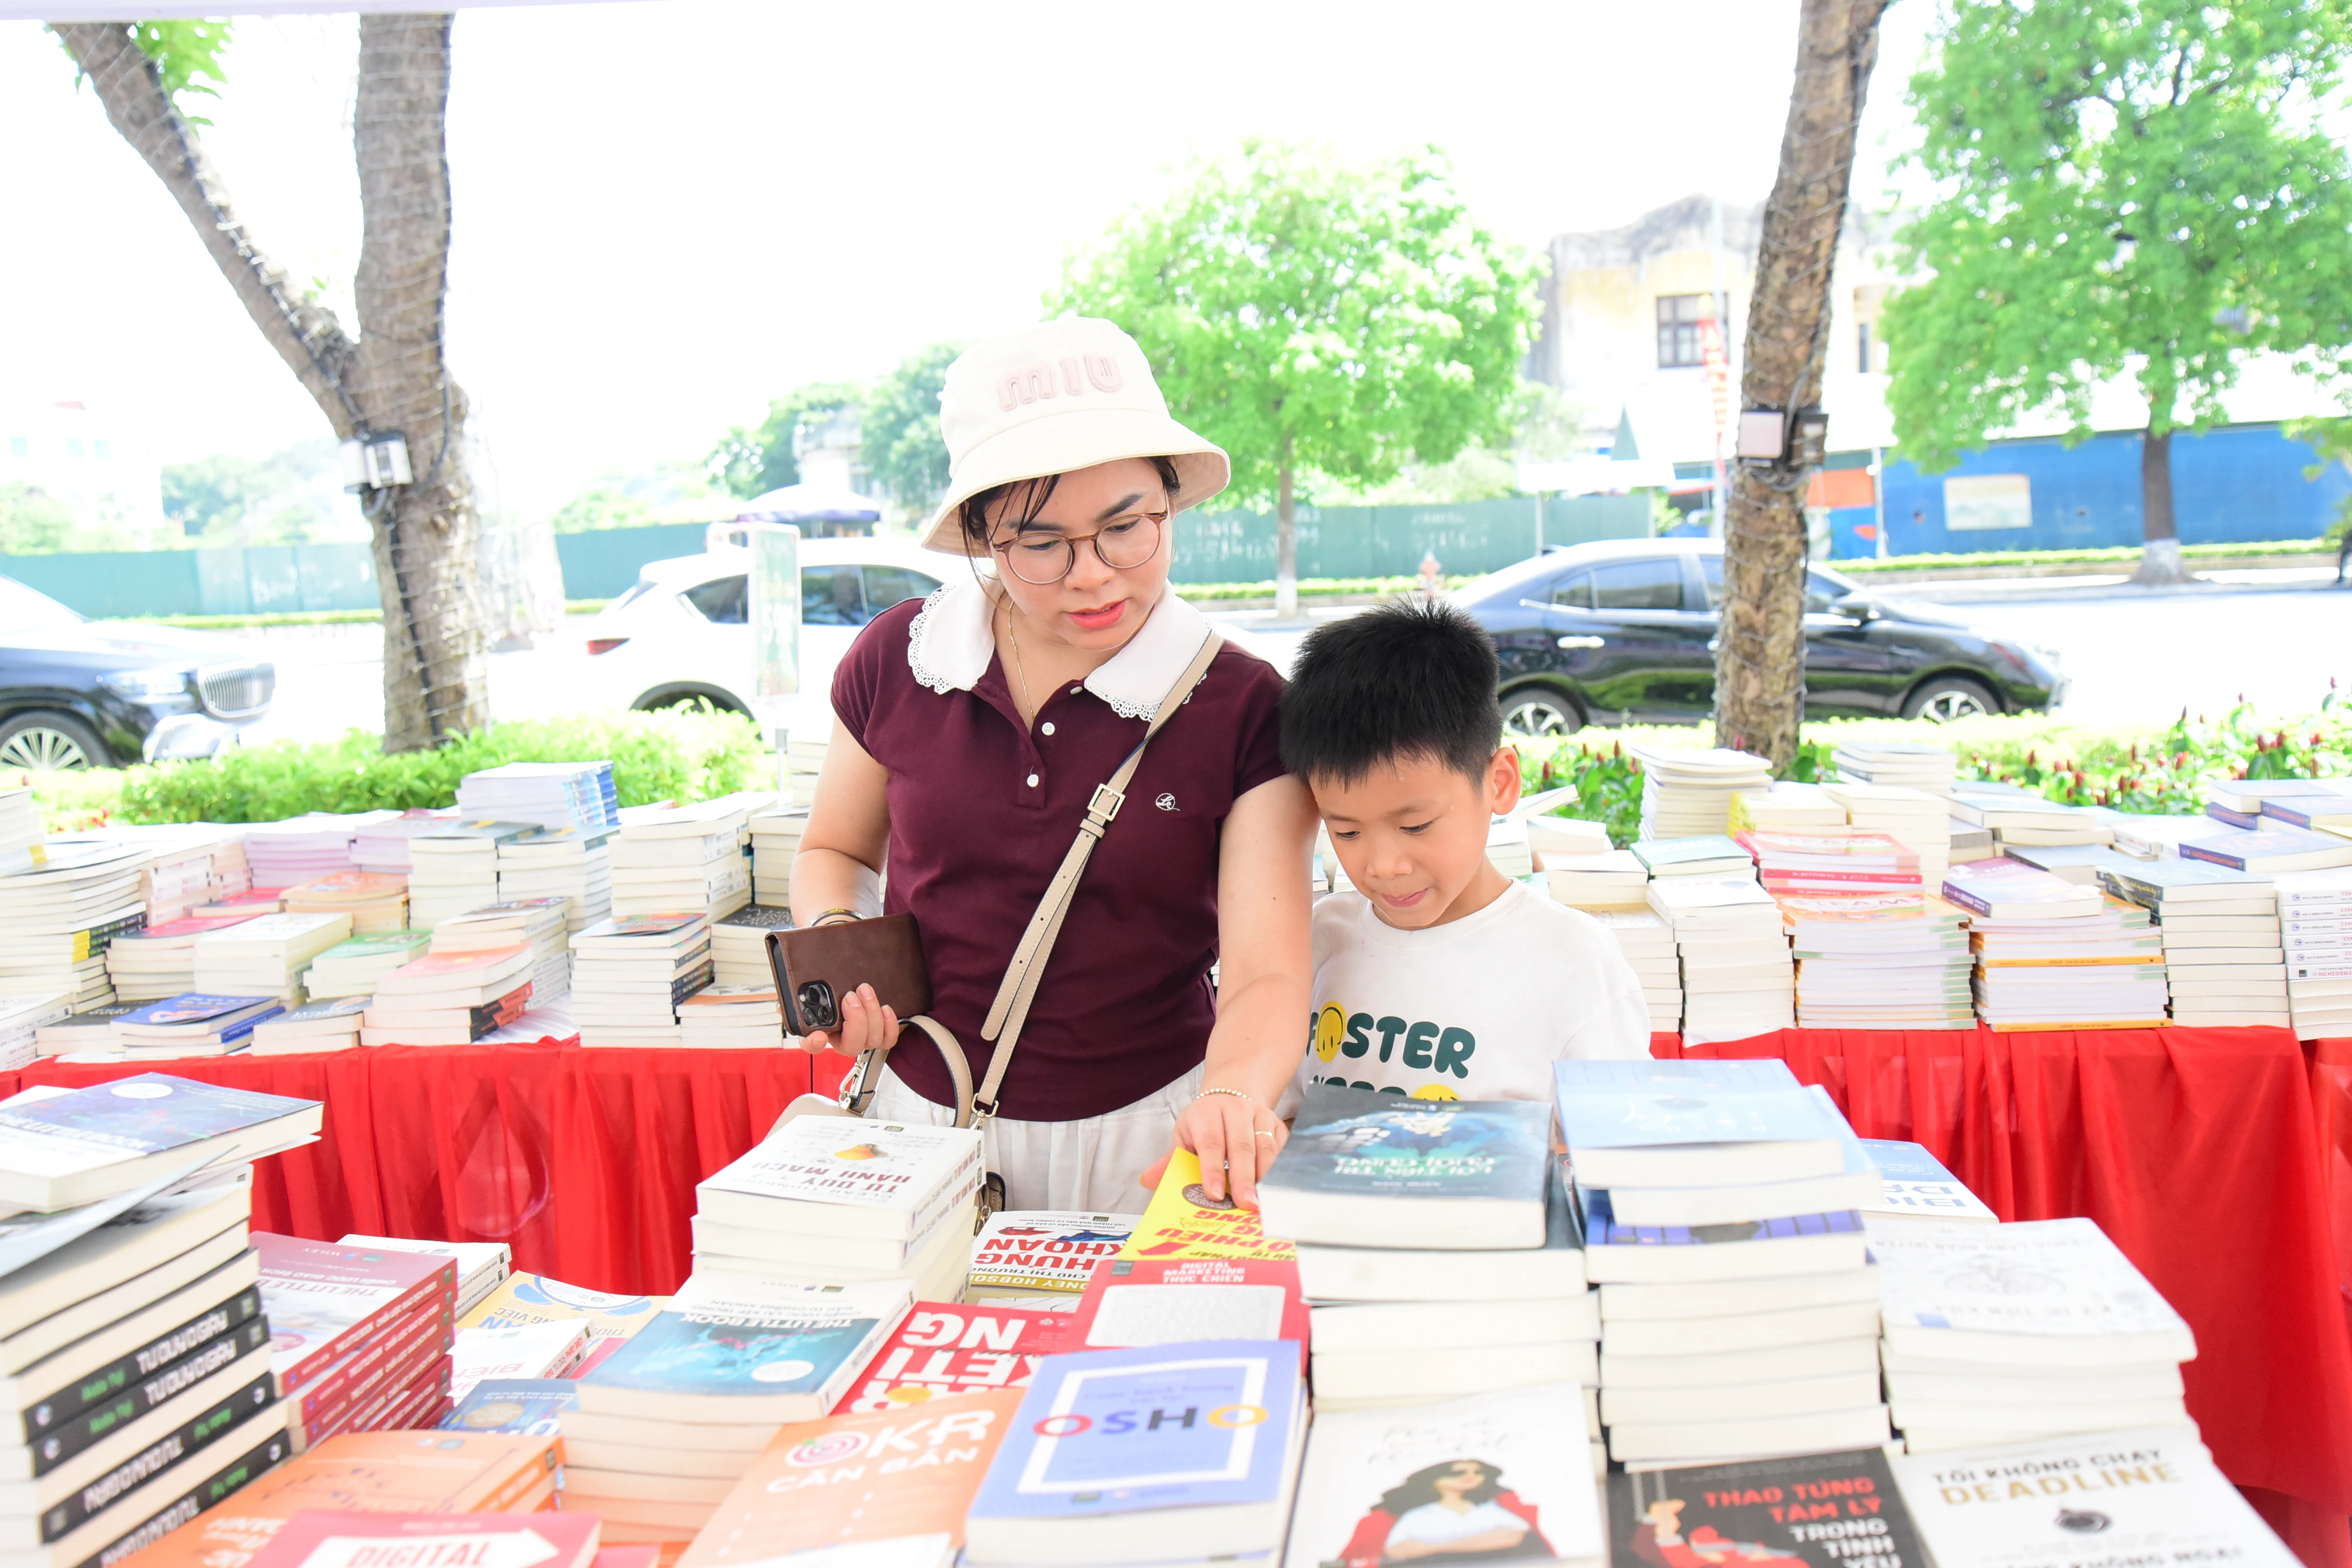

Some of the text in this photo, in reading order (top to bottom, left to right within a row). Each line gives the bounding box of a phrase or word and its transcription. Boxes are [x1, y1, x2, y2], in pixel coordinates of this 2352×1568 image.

[800, 1177, 856, 1190] DUY
[974, 1253, 1096, 1271] HỨNG
[1163, 1267, 1245, 1276] MARKETING
[971, 1273, 1038, 1287] HOBSO
[1028, 1269, 1054, 1277] THỊ
[494, 1307, 529, 1324] VIỆC
[595, 1328, 626, 1336] TRO
[900, 1311, 1027, 1351] NG
[1033, 1402, 1269, 1437] OSHO
[764, 1446, 979, 1494] CĂN BẢN
[1940, 1462, 2183, 1506] DEADLINE
[1702, 1485, 1783, 1509] THAO
[1787, 1518, 1888, 1544] TRONG
[346, 1542, 491, 1568] DIGITAL
